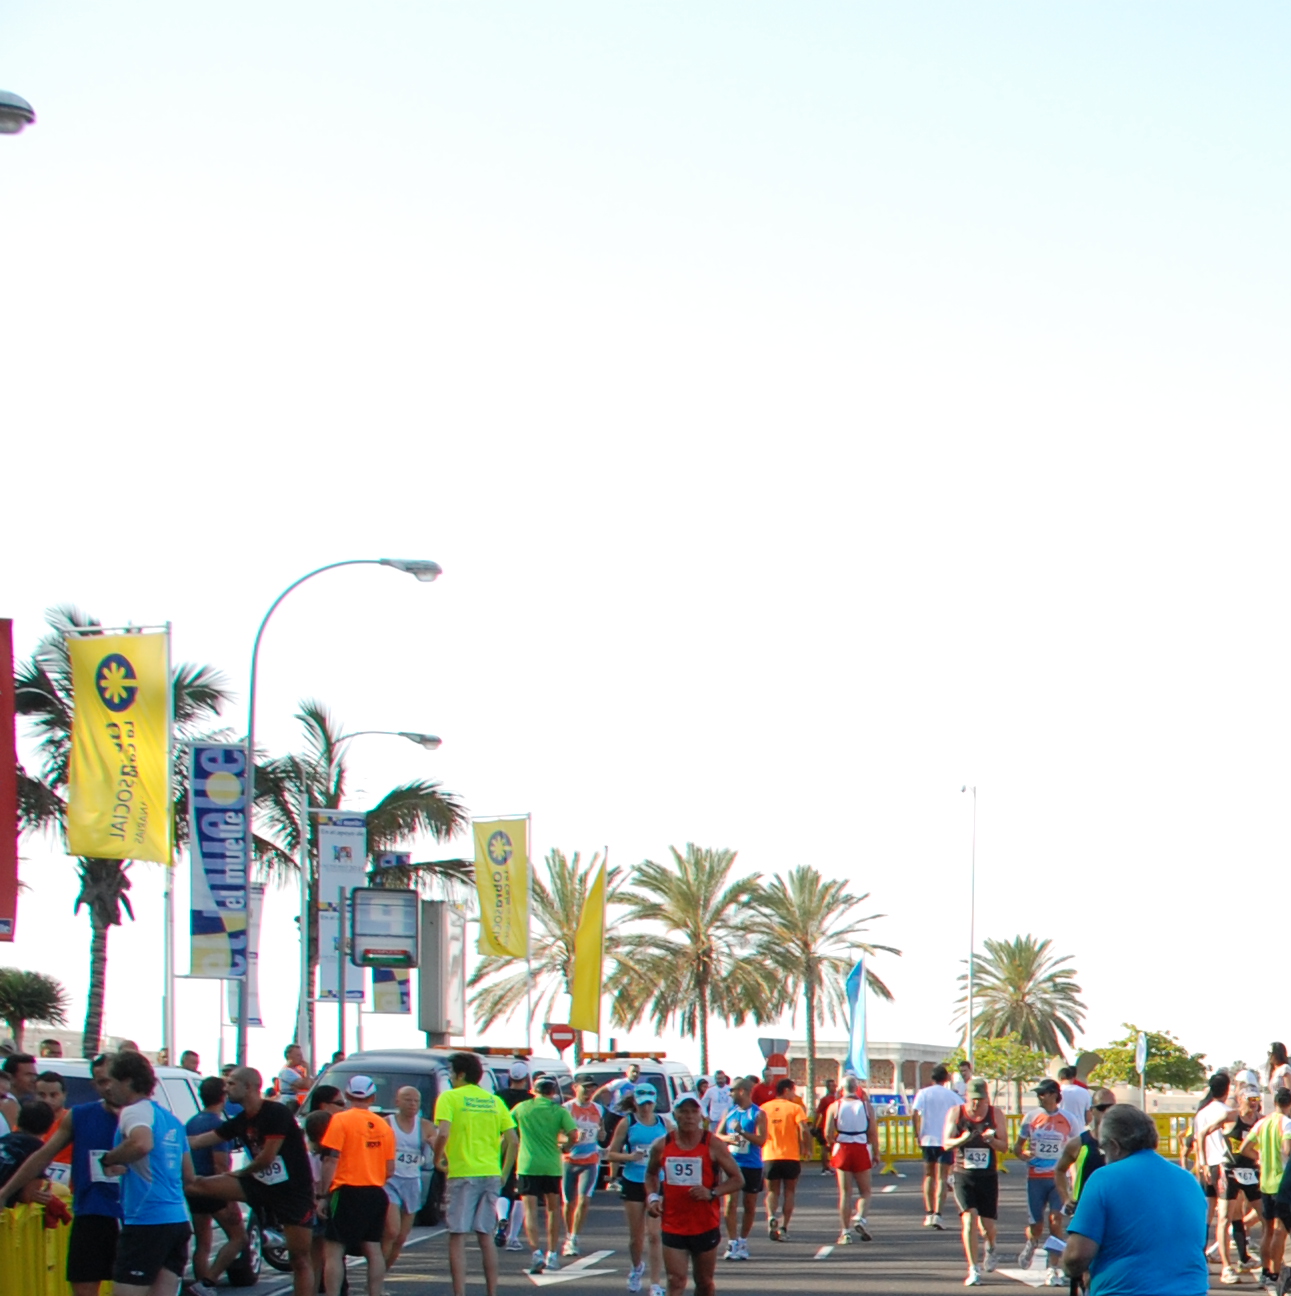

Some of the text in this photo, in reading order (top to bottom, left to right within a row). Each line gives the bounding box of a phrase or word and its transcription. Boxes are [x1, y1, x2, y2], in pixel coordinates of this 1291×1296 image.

[219, 811, 246, 909] el muelle
[1039, 1143, 1059, 1153] 225
[968, 1152, 988, 1162] 432
[674, 1163, 694, 1177] 95
